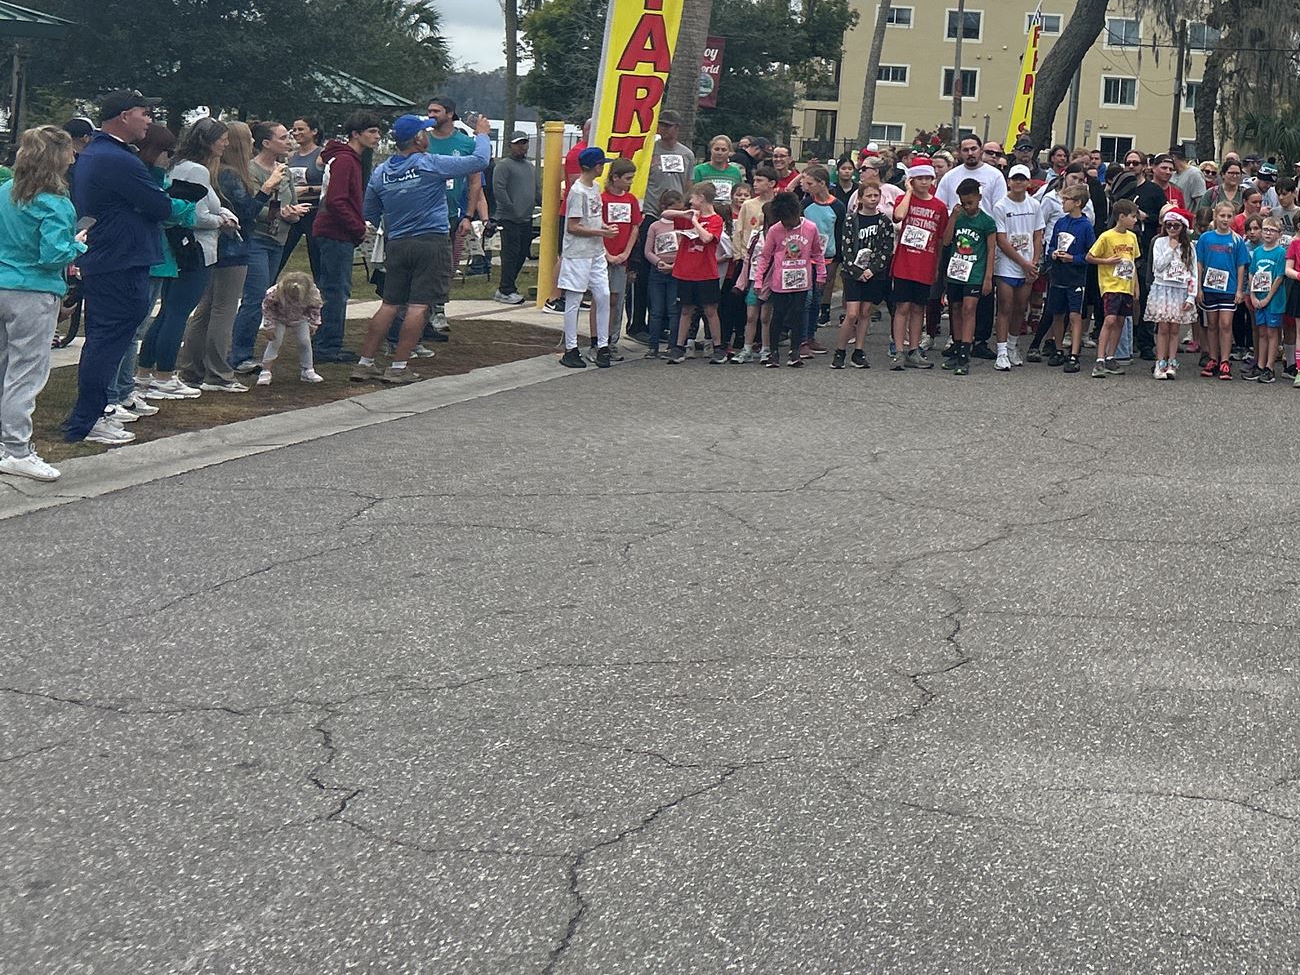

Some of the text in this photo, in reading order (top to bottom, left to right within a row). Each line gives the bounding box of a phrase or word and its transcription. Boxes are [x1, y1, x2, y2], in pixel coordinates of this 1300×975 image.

[704, 48, 719, 61] oy
[701, 65, 720, 74] orld
[858, 225, 879, 240] OYFU
[956, 228, 980, 241] ANTA'S
